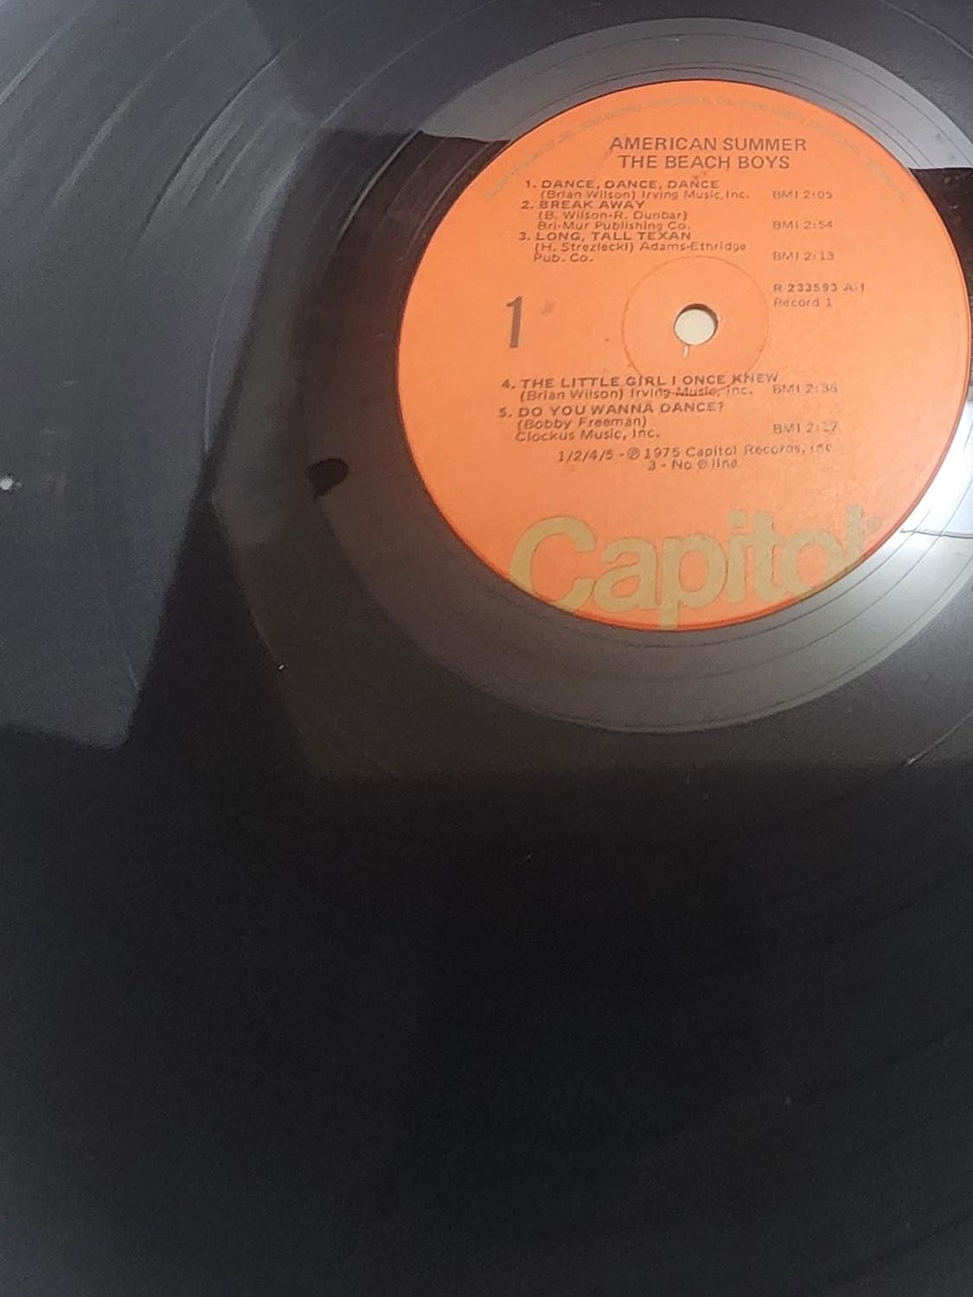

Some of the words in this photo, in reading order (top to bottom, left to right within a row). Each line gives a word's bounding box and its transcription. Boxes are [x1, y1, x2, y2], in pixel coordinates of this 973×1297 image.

[608, 136, 717, 151] AMERICAN
[722, 137, 807, 151] SUMMER
[618, 154, 658, 169] THE
[664, 155, 730, 170] BEACH
[738, 155, 790, 169] BOYS
[525, 180, 537, 190] 1.
[541, 180, 601, 191] DANCE,
[604, 180, 663, 191] DANCE,
[667, 179, 720, 190] DANCE
[541, 189, 582, 201] (Brian
[586, 189, 636, 201] Wilson)
[641, 189, 679, 201] Irving
[772, 190, 799, 200] BMI
[521, 201, 534, 210] 2.
[539, 201, 594, 210] BREAK
[599, 200, 646, 210] AWAY
[538, 211, 559, 221] (B.
[633, 210, 688, 221] Dunbar)
[537, 221, 590, 231] Bri-Mur
[595, 221, 663, 232] Publishing
[668, 221, 691, 231] Co.
[772, 220, 799, 230] BMI
[803, 220, 833, 230] 2:54
[518, 232, 531, 242] 3.
[536, 232, 586, 243] LONG,
[591, 232, 632, 241] TALL
[638, 232, 692, 241] TEXAN
[535, 242, 558, 253] (H.
[533, 253, 566, 263] Pub.
[570, 253, 595, 263] Co.
[772, 251, 799, 261] BMI
[773, 283, 783, 293] R
[773, 297, 820, 308] Record
[506, 296, 523, 349] 1
[501, 379, 515, 390] 4.
[520, 378, 555, 389] THE
[561, 377, 621, 389] LITTLE
[625, 375, 667, 387] GIRL
[682, 374, 726, 385] ONCE
[732, 372, 779, 384] KNEW
[520, 389, 566, 402] (Brian
[570, 387, 624, 401] Wilson)
[630, 387, 670, 400] Irving
[772, 383, 800, 394] BMI
[498, 407, 513, 418] 5.
[518, 406, 543, 418] DO
[550, 405, 586, 417] YOU
[591, 402, 654, 415] WANNA
[660, 402, 724, 414] DANCE?
[517, 418, 572, 432] (Bobby
[578, 416, 647, 429] Freeman)
[515, 430, 576, 443] Clockus
[580, 429, 627, 442] Music,
[632, 428, 661, 440] Inc.
[773, 422, 800, 434] BMI
[557, 450, 614, 463] 1/2/4/5
[685, 445, 737, 458] Capitol
[744, 444, 806, 457] Records,
[672, 459, 692, 470] No
[510, 505, 865, 631] Capitol
